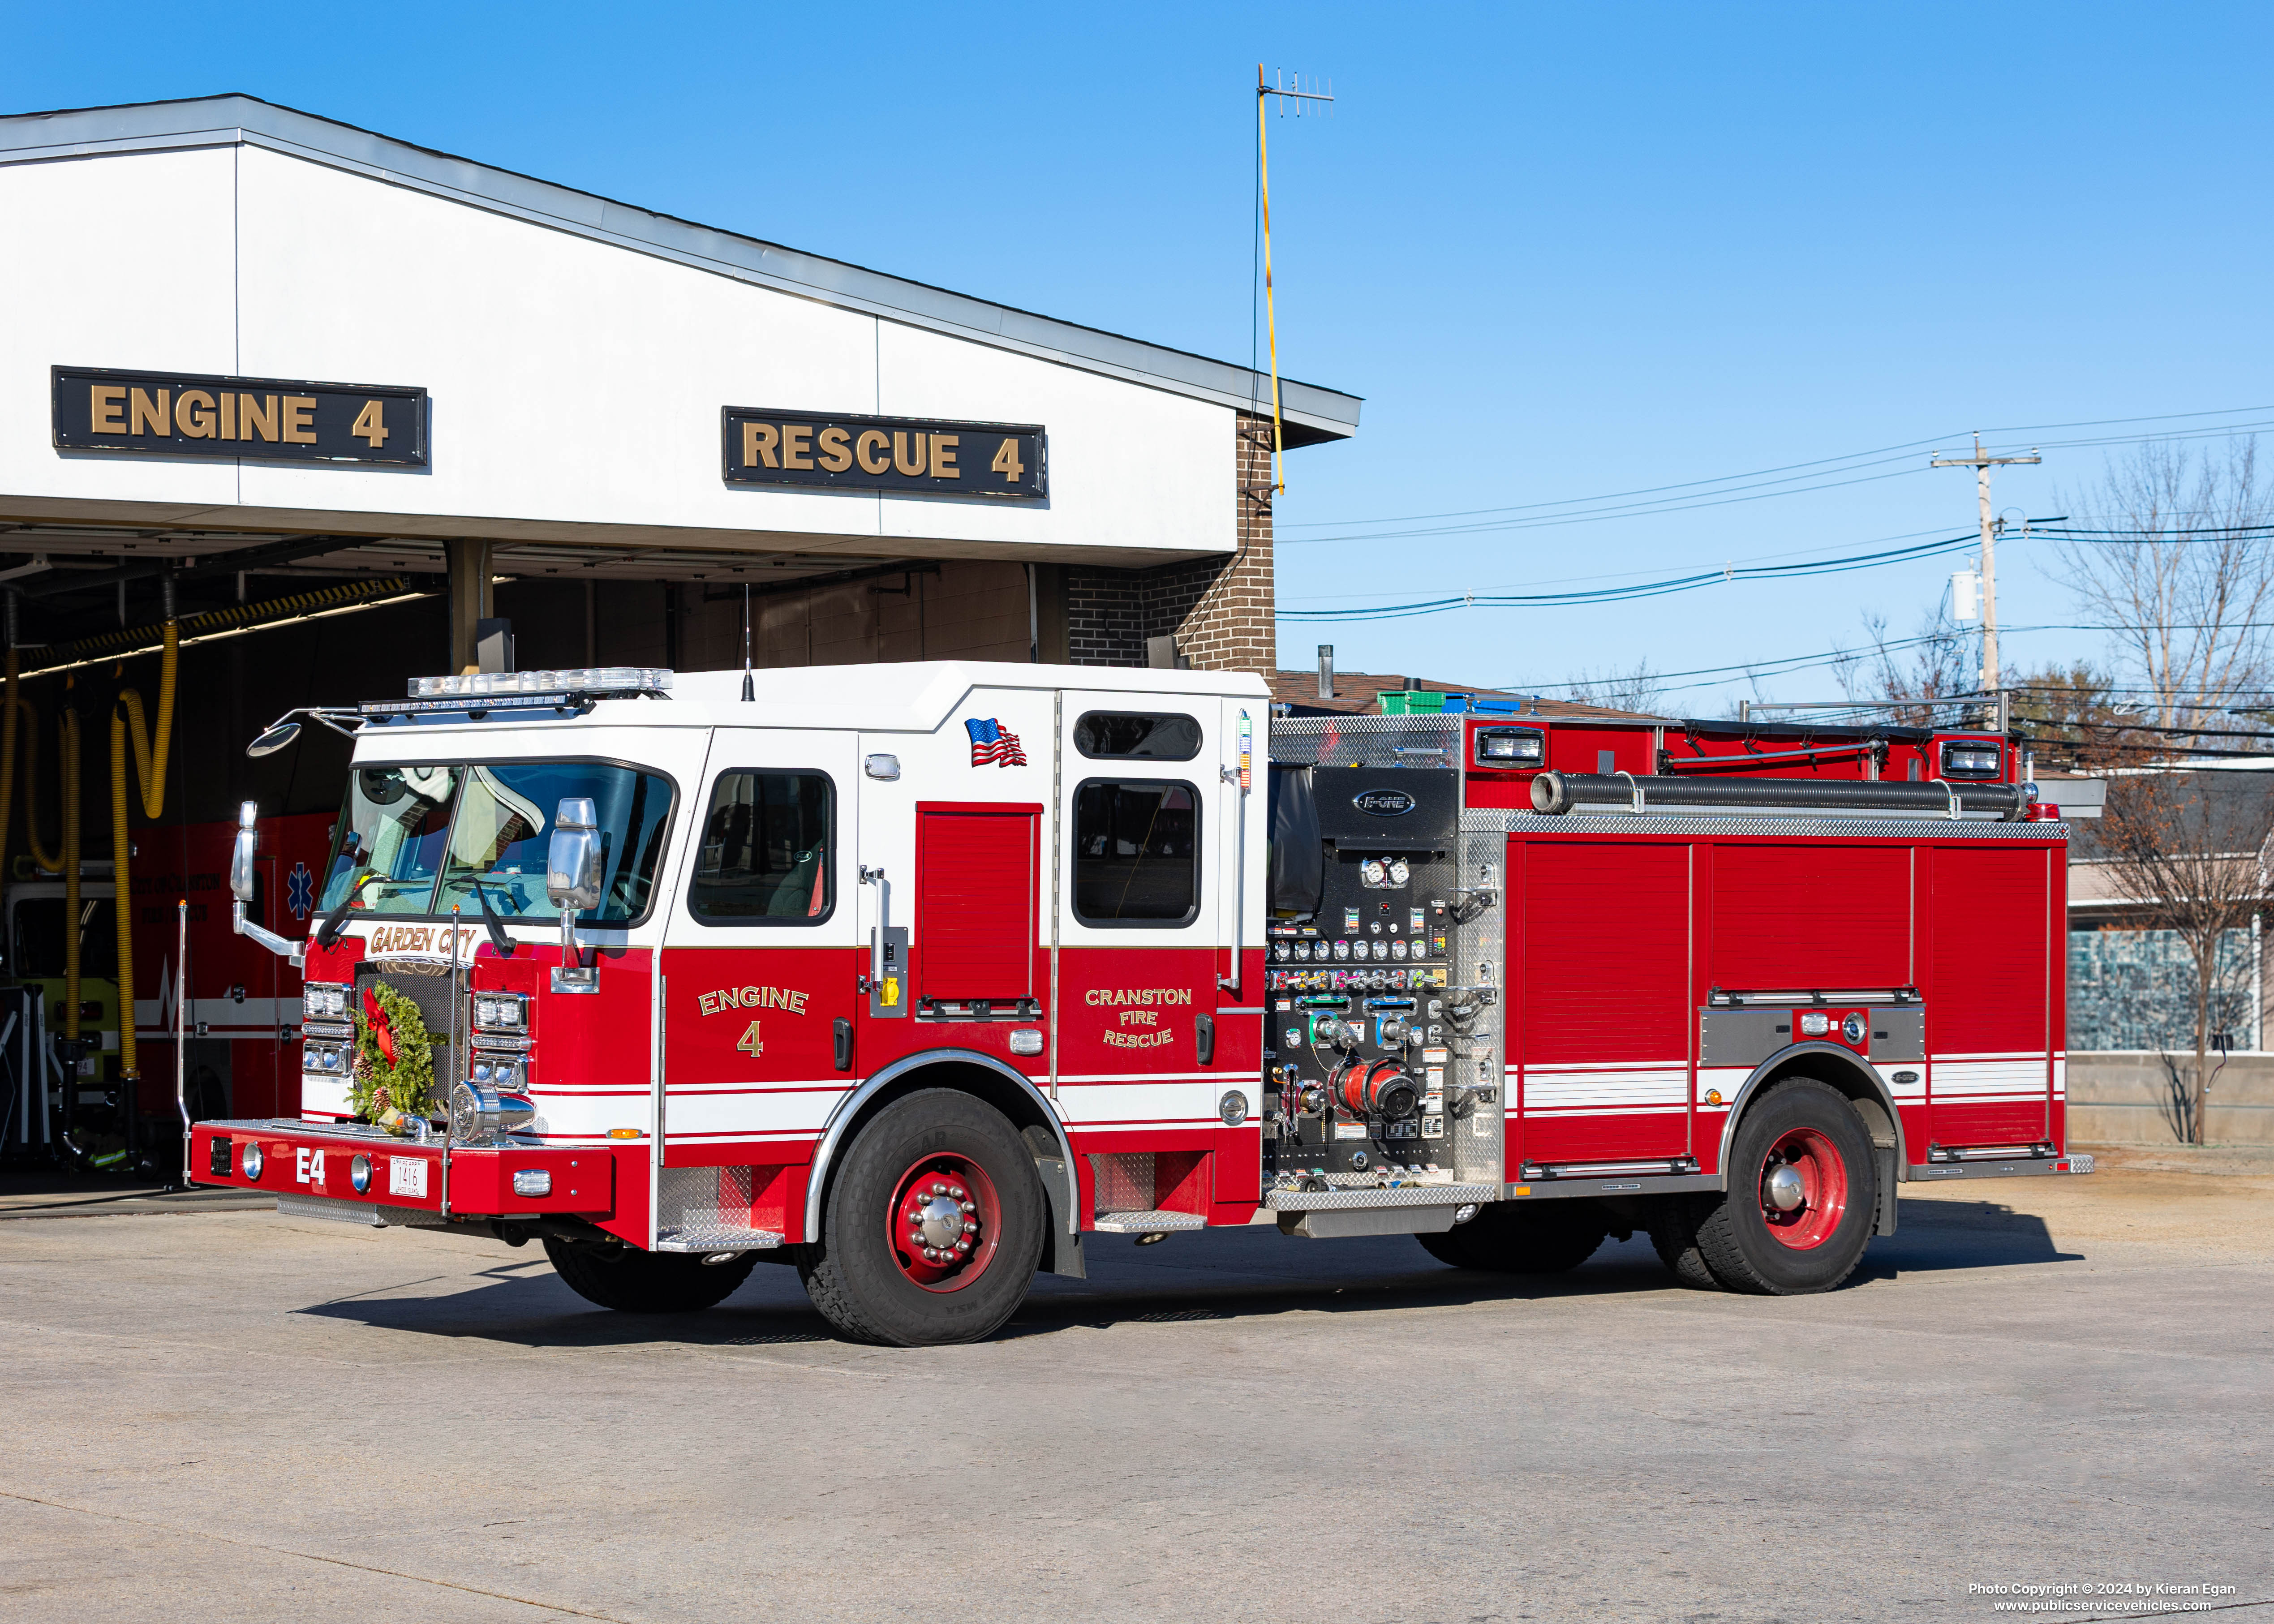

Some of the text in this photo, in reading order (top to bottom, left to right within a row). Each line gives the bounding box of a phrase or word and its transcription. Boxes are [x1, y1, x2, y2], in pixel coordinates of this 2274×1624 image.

[91, 385, 389, 448] ENGINE 4
[743, 422, 1024, 483] RESCUE 4
[1363, 796, 1406, 809] E-ONE
[370, 927, 436, 954] GARDEN
[698, 986, 809, 1016] ENGINE
[1085, 988, 1192, 1006] CRANSTON
[1119, 1010, 1158, 1027] FIRE
[736, 1021, 763, 1058] 4
[1103, 1028, 1174, 1048] RESCUE
[296, 1147, 325, 1186] E4
[399, 1167, 417, 1186] 1416
